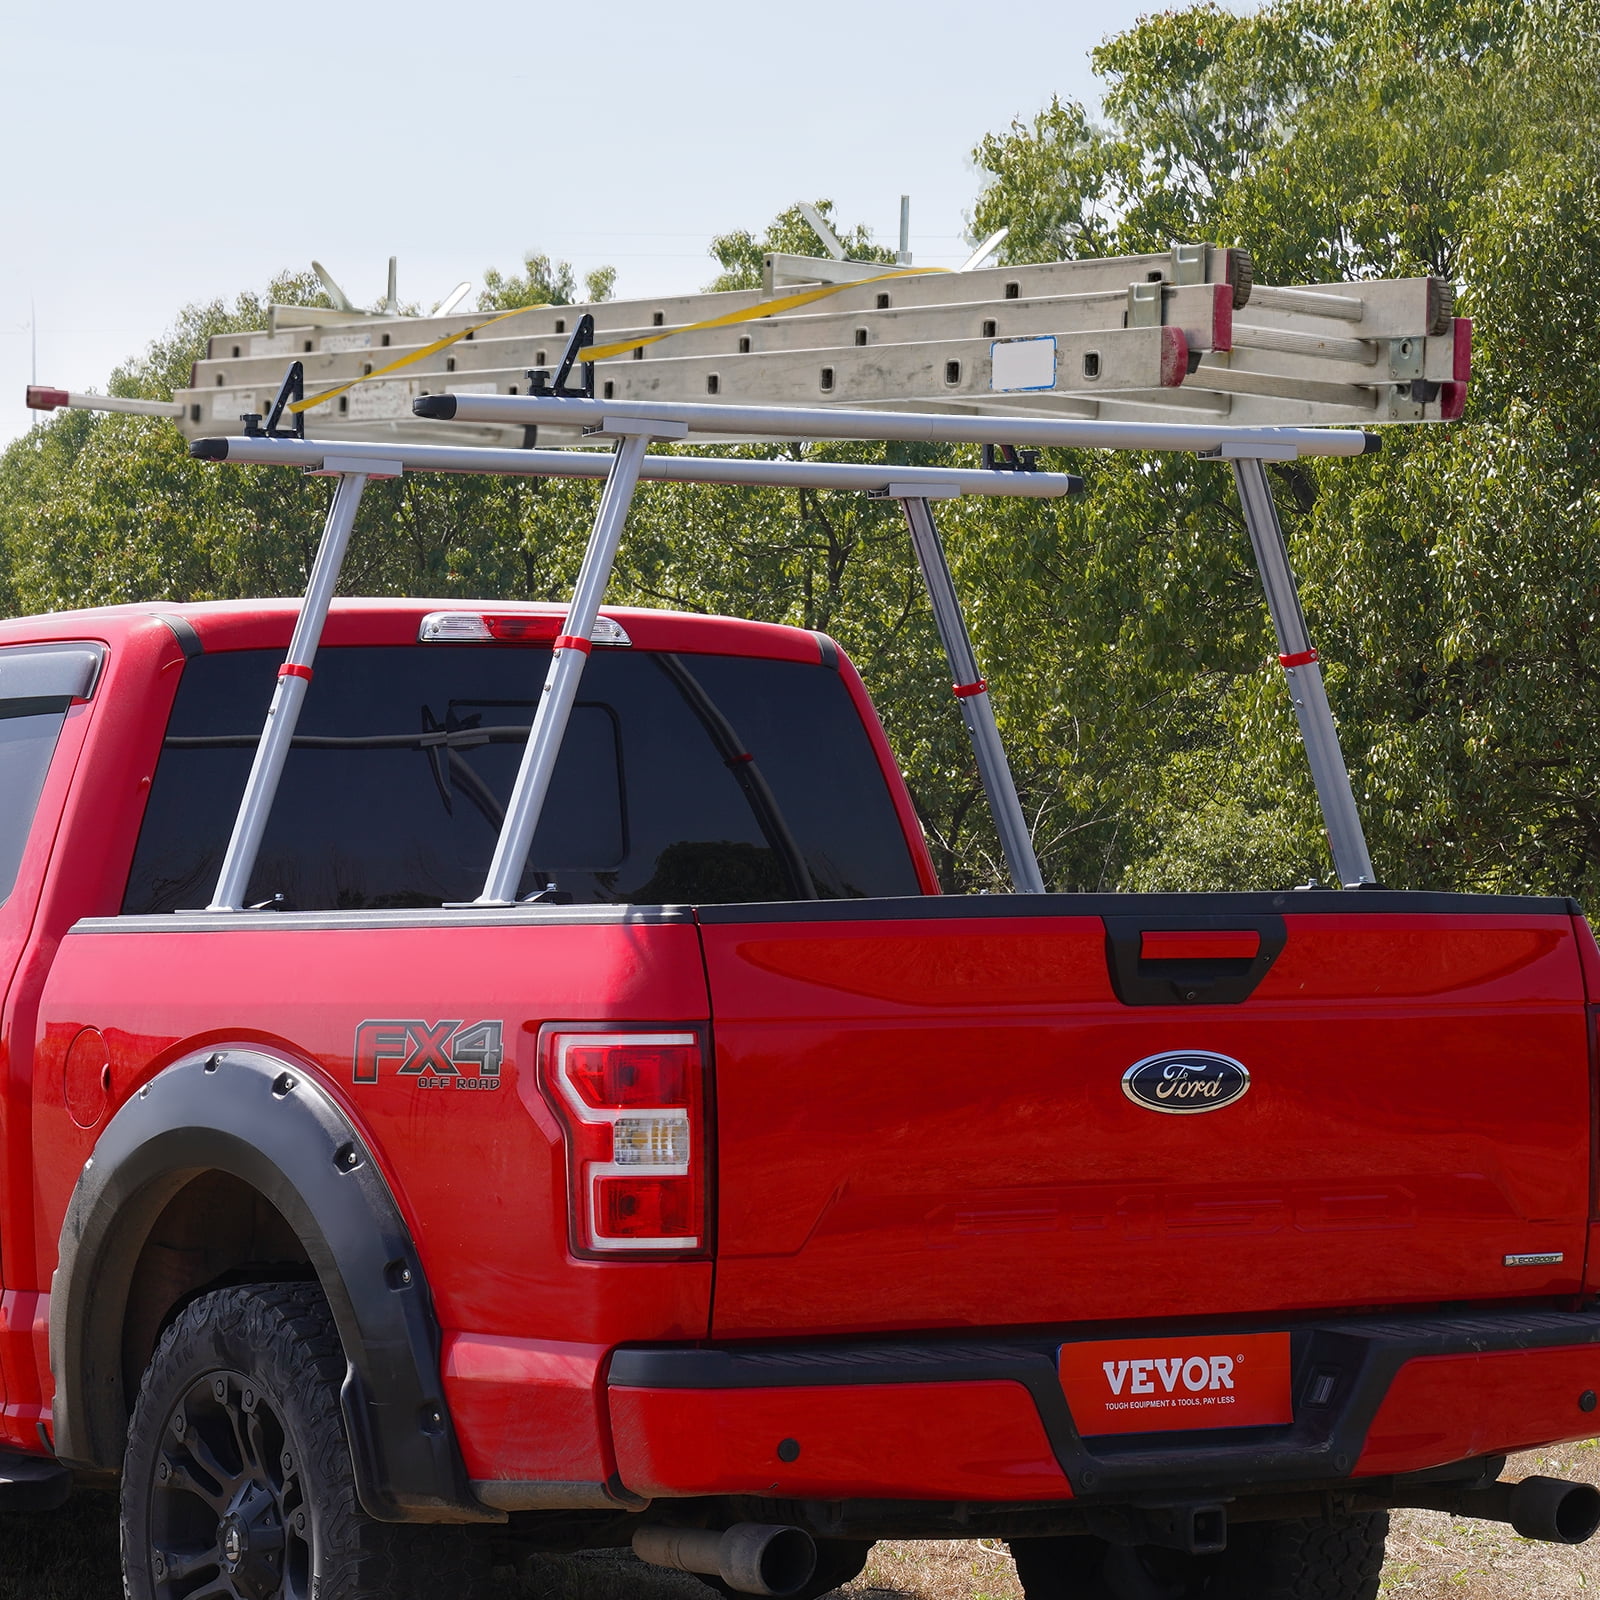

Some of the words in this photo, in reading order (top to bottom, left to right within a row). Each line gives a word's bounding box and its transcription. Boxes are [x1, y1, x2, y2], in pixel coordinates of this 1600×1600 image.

[353, 1019, 504, 1084] FX4
[417, 1076, 450, 1089] OFF
[456, 1078, 500, 1090] ROAD
[1156, 1064, 1224, 1098] Ford
[1103, 1356, 1234, 1395] VEVOR
[1105, 1402, 1129, 1410] TOUGH
[1130, 1400, 1170, 1410] EQUIPMENT
[1178, 1398, 1202, 1407] TOOLS,
[1203, 1397, 1216, 1405] PAY
[1217, 1395, 1236, 1404] LESS
